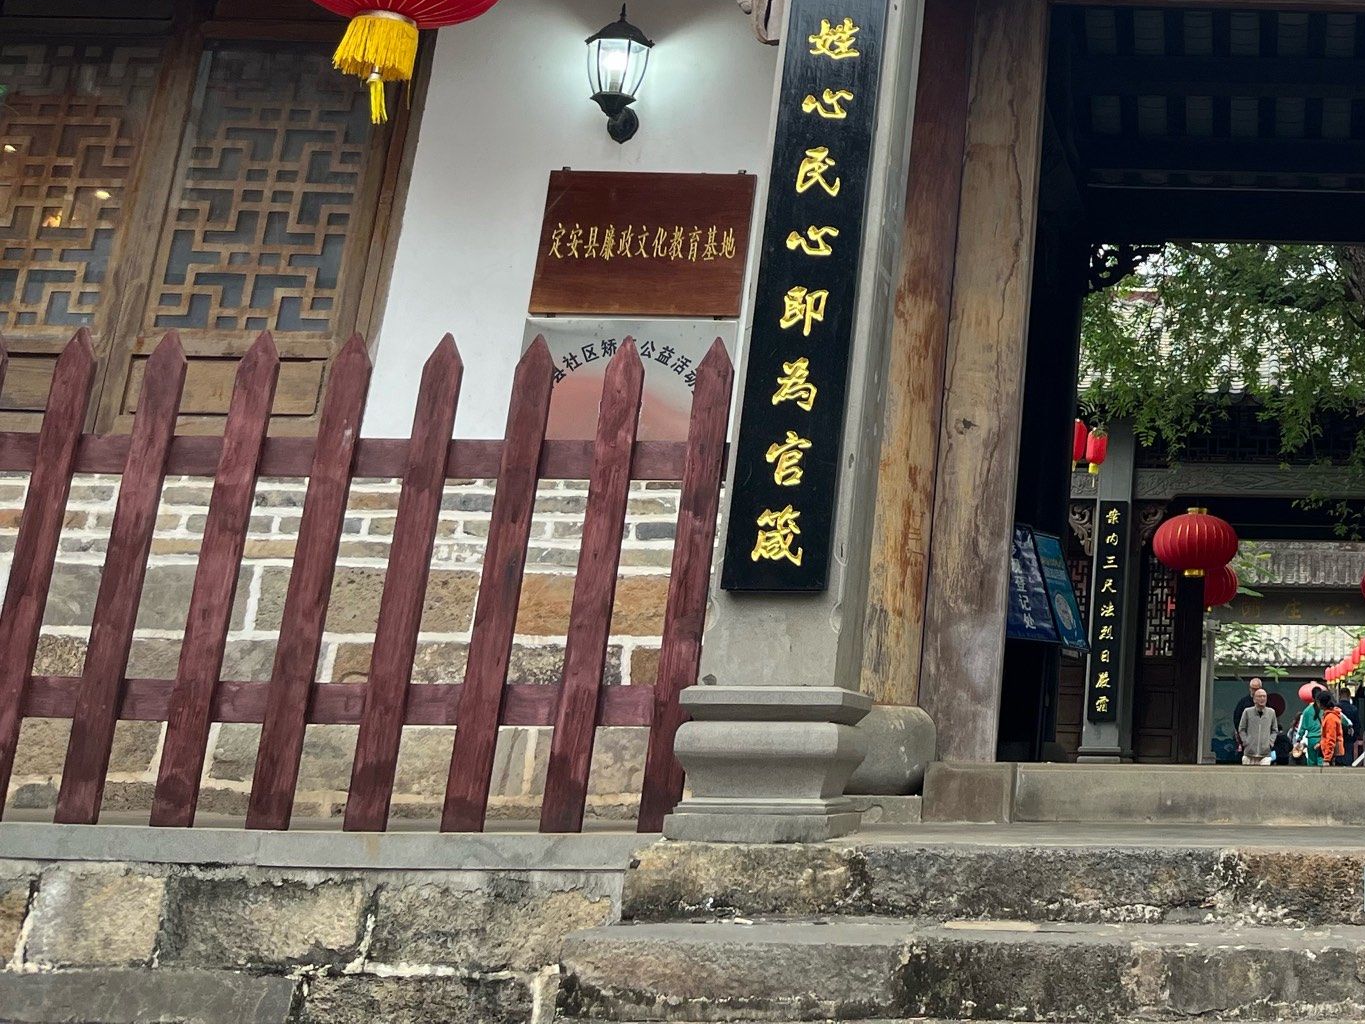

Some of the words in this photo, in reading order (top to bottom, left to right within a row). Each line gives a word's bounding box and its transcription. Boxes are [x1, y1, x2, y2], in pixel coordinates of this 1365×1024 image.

[548, 222, 736, 263] 定安县廉政文化教育基地
